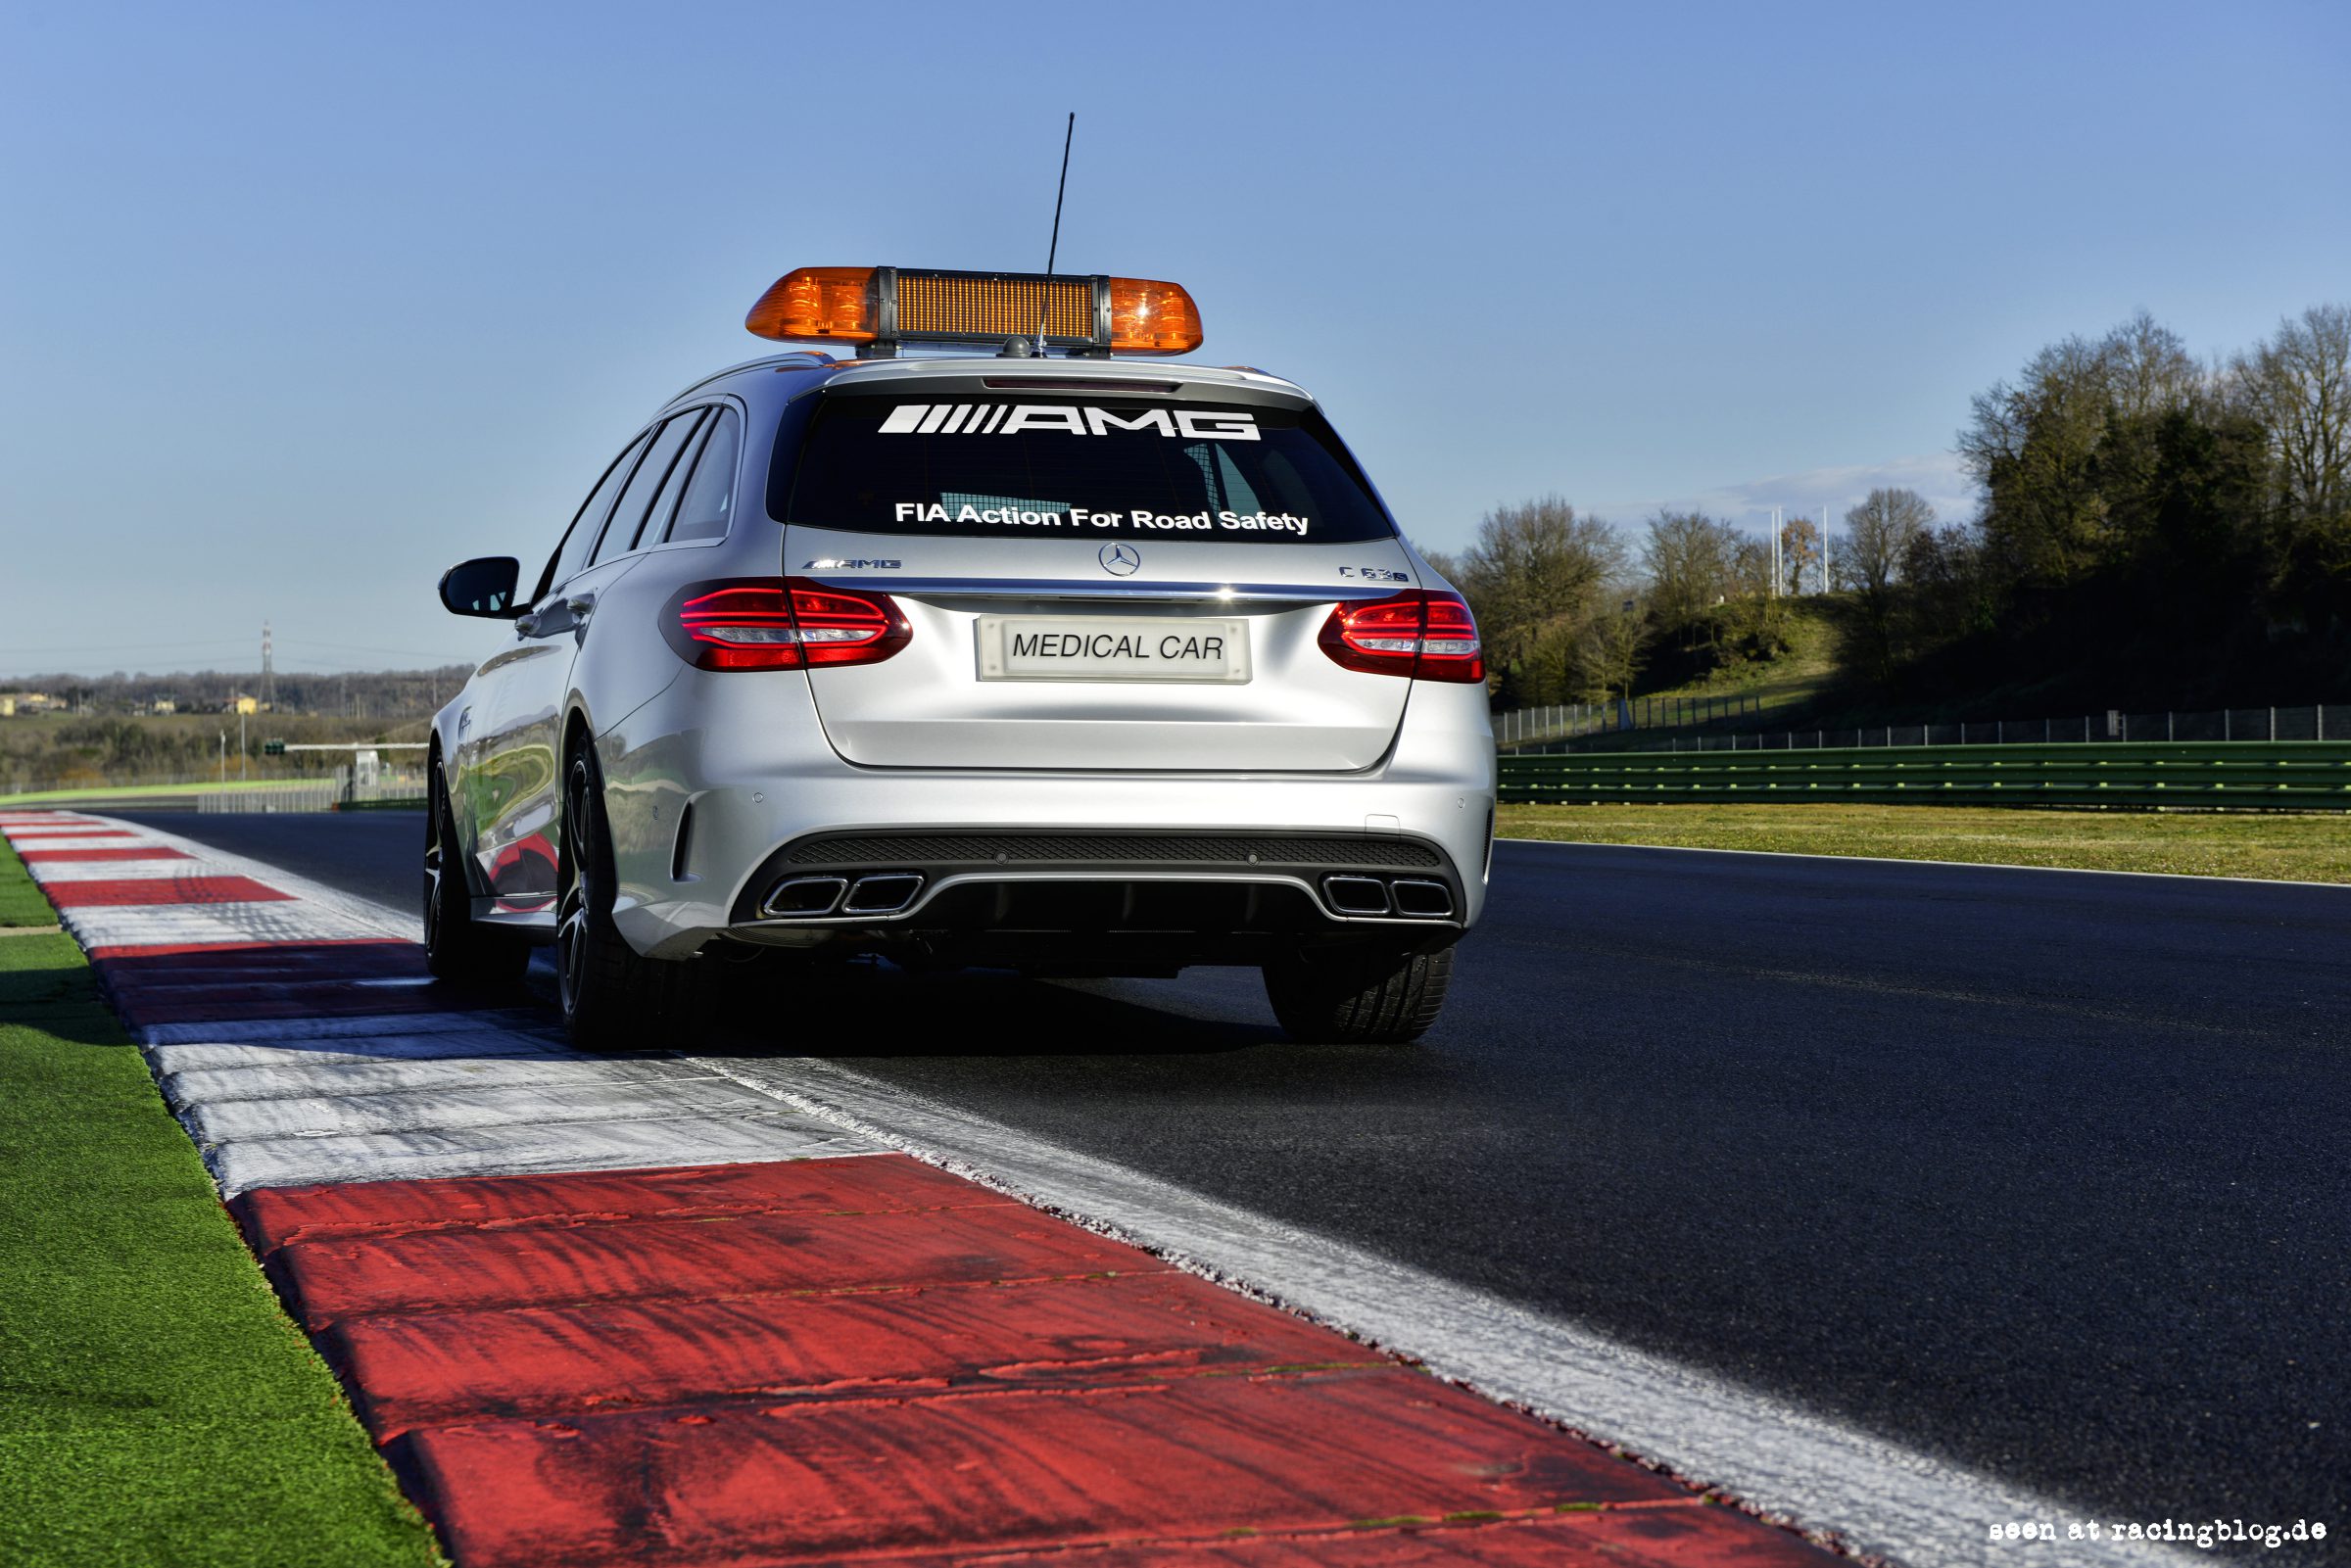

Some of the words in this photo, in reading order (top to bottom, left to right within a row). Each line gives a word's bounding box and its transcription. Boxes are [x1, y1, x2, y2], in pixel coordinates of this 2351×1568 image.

[999, 404, 1262, 441] AMG
[894, 502, 951, 523] FIA
[956, 503, 1062, 526] Action
[1070, 507, 1124, 528] For
[1130, 510, 1213, 531] Road
[1220, 511, 1309, 536] Safety
[836, 559, 902, 569] AMG
[1338, 566, 1355, 578] C
[1012, 633, 1151, 658] MEDICAL
[1159, 635, 1223, 660] CAR
